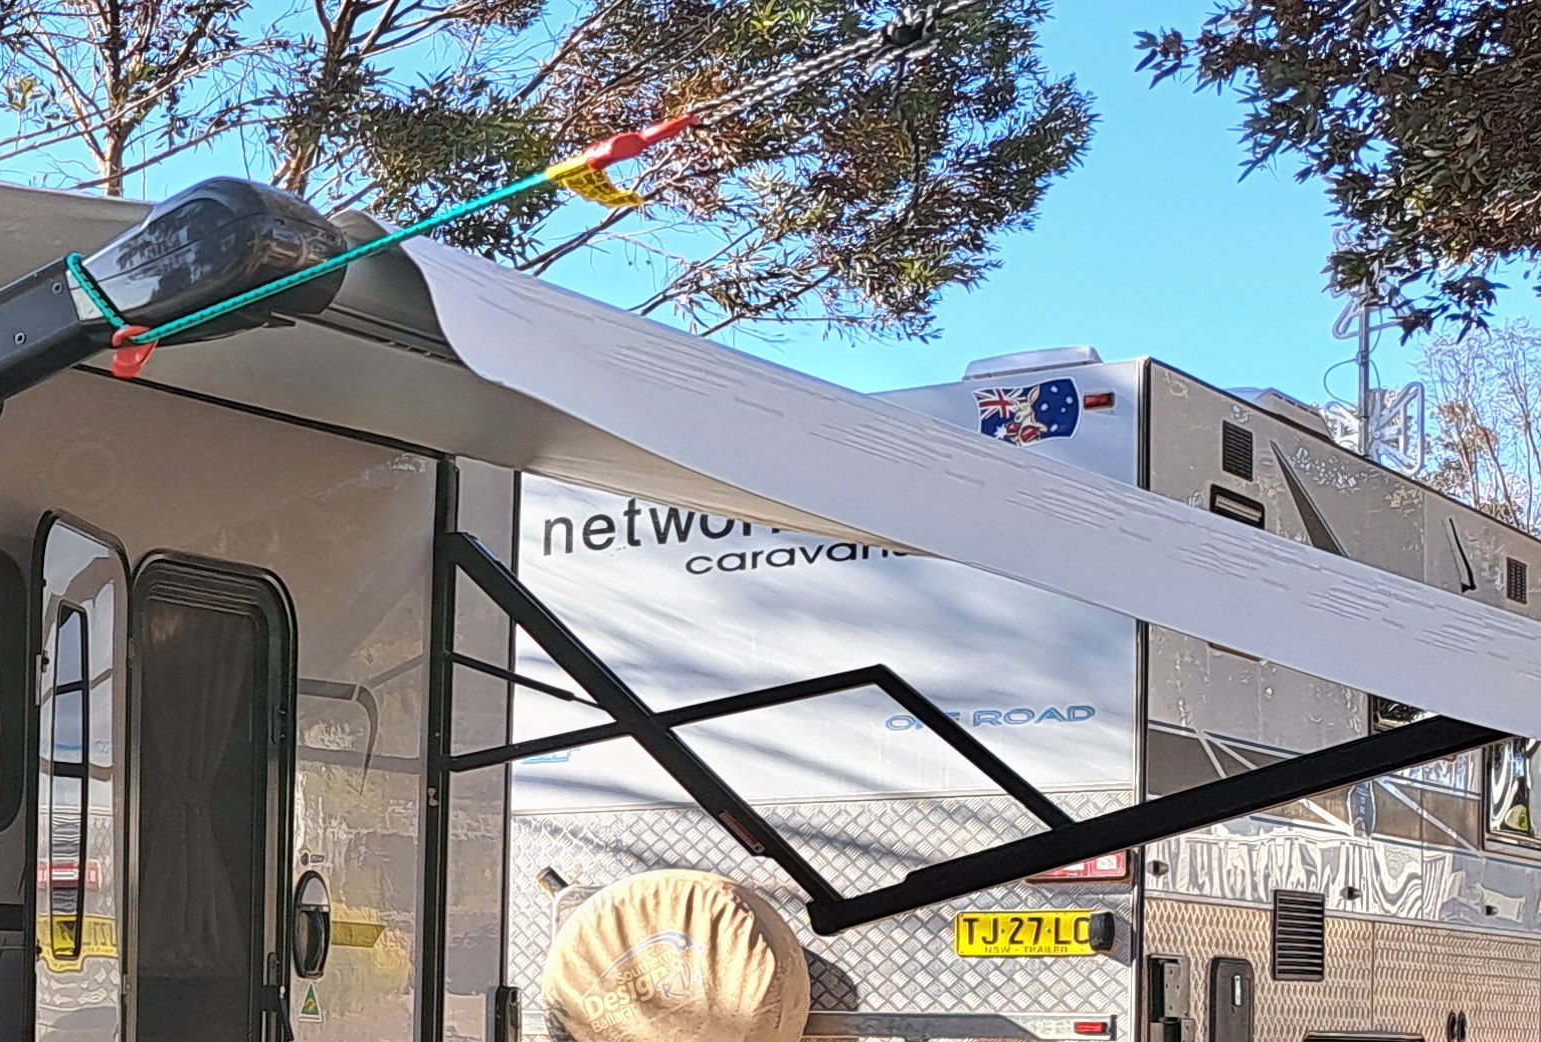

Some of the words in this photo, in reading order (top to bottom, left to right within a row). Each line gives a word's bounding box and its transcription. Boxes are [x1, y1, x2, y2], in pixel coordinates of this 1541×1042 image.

[972, 705, 1096, 727] ROAD
[984, 946, 1011, 954] NSW
[1021, 946, 1068, 954] TRAILER
[616, 952, 681, 985] Southern
[583, 964, 670, 1023] Design
